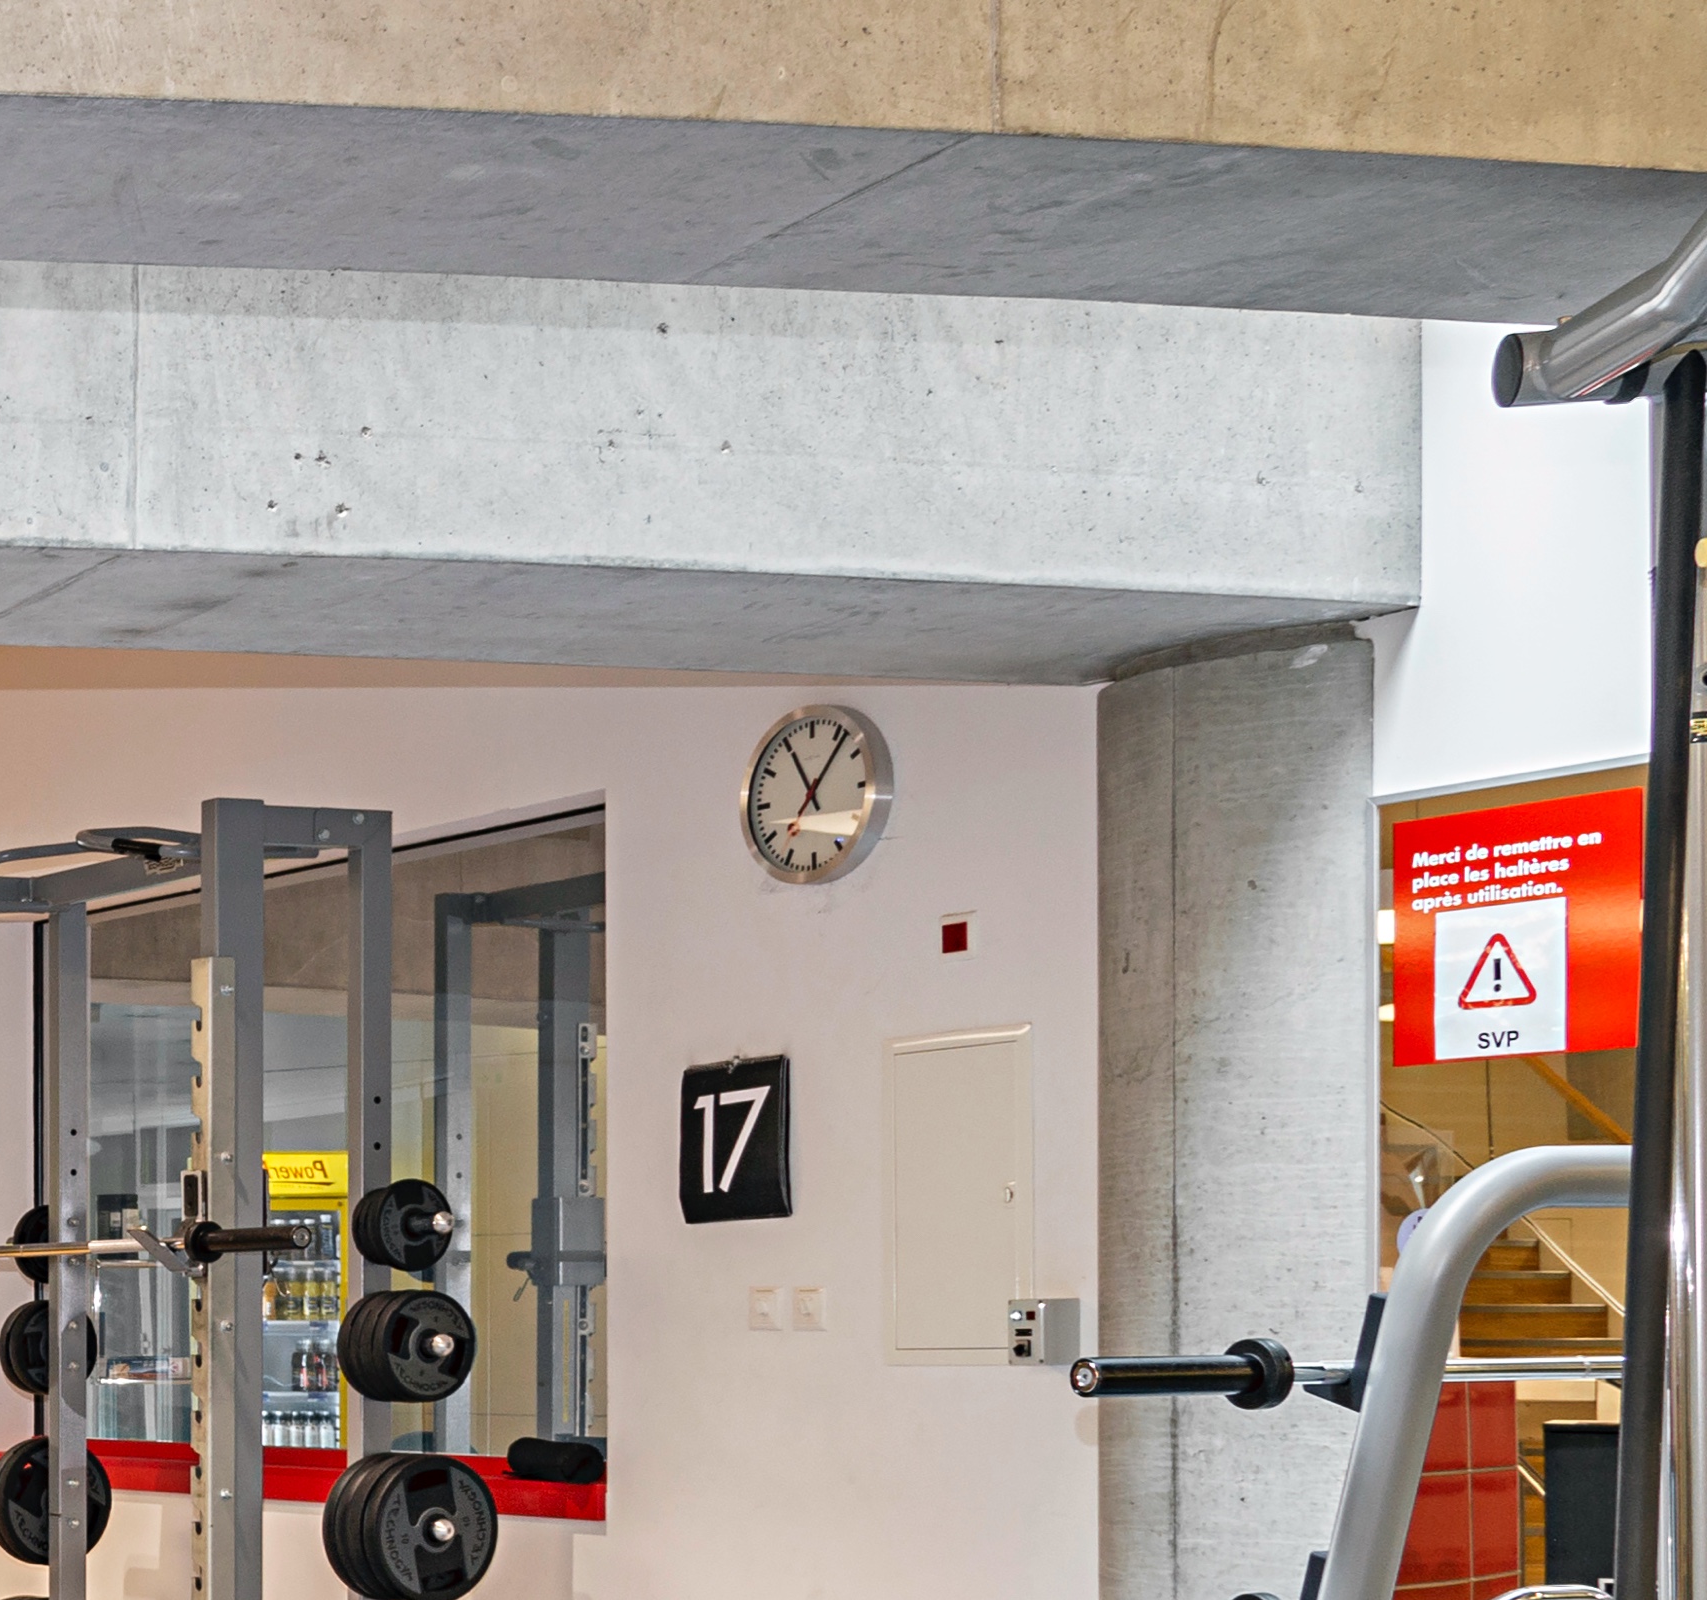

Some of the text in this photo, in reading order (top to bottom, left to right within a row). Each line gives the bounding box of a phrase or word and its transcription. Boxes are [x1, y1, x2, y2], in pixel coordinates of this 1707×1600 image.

[1412, 832, 1602, 868] Merci de remettre en
[1412, 858, 1569, 894] place les haltères
[1412, 880, 1563, 914] après utilisation.
[1477, 1030, 1519, 1049] SVP
[693, 1084, 771, 1194] 17
[14, 1510, 49, 1550] TECHNO
[385, 1493, 413, 1581] TECHNOGYM
[458, 1480, 487, 1566] TECHNOGYM
